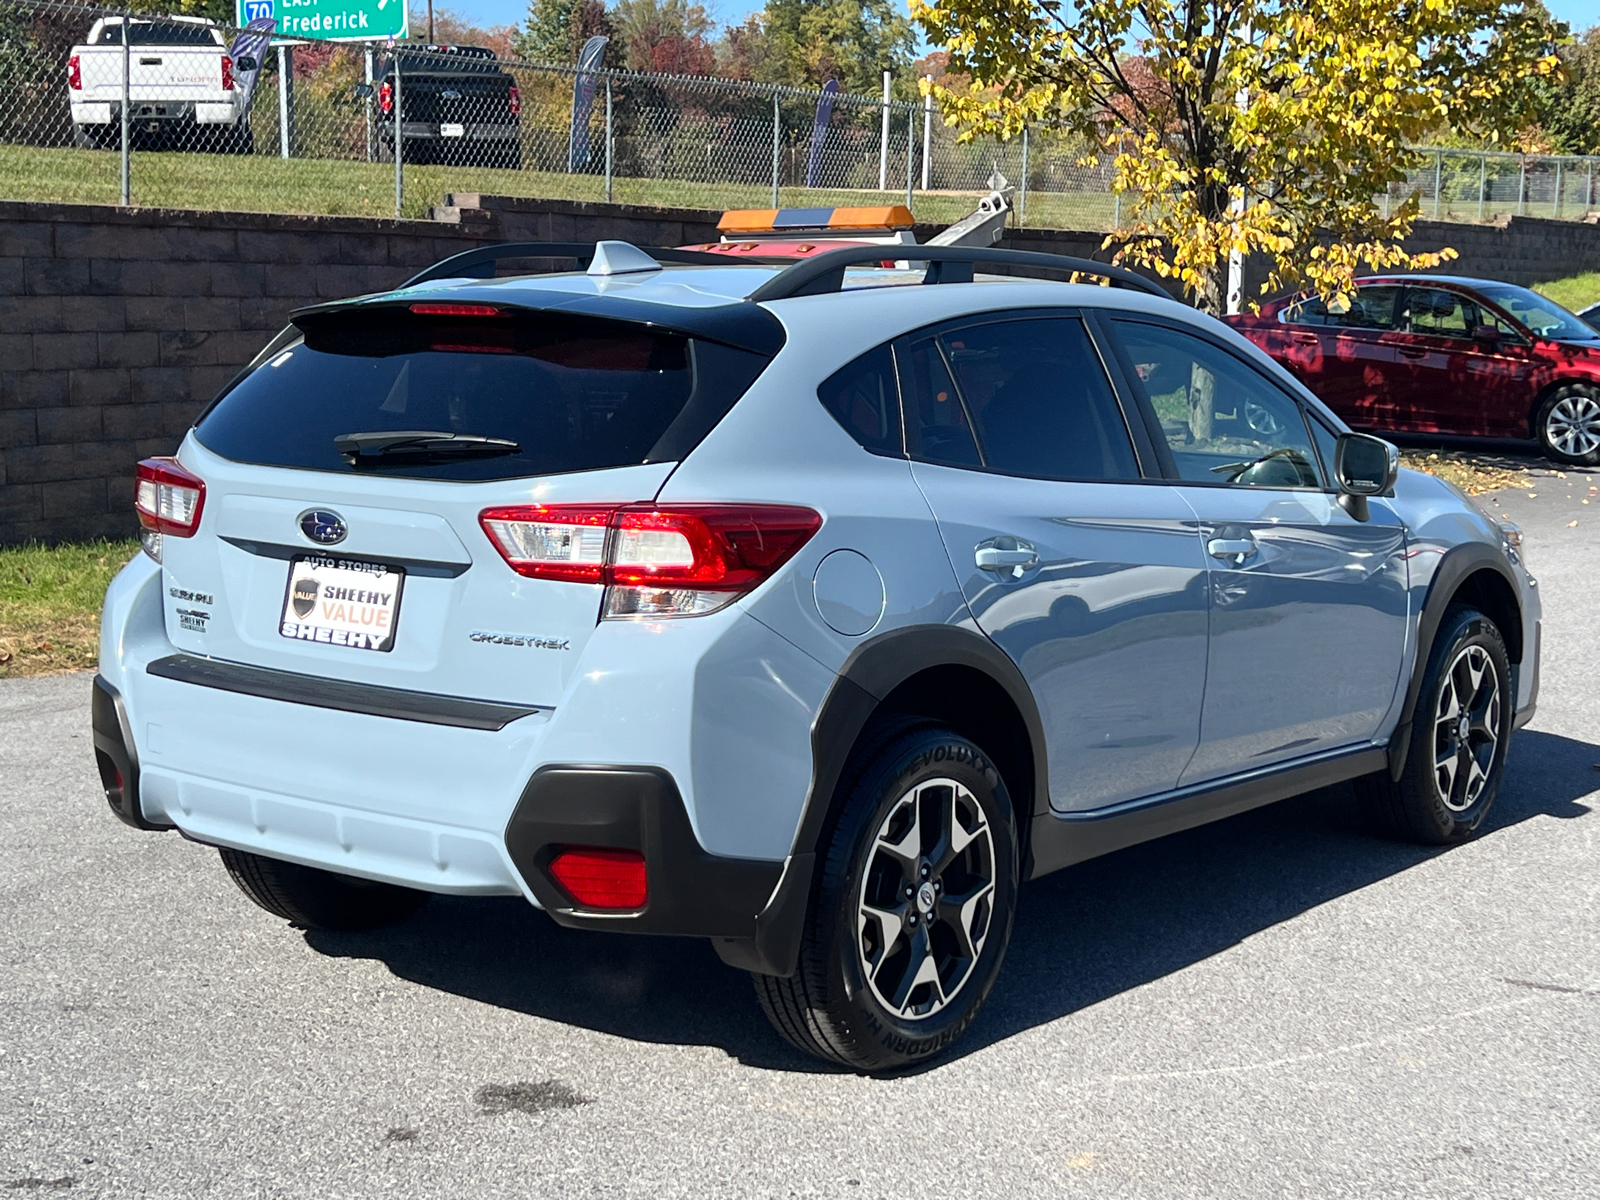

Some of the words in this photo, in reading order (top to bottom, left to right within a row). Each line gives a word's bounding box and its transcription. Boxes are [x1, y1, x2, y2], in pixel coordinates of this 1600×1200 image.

[249, 3, 270, 21] 70
[282, 10, 369, 33] Frederick
[302, 556, 335, 569] AUTO
[338, 559, 388, 575] STORES
[293, 590, 316, 601] VALUE
[323, 585, 392, 606] SHEEHY
[322, 601, 390, 628] VALUE
[281, 621, 391, 650] SHEEHY
[469, 630, 570, 651] CROSSTREK
[908, 744, 990, 777] EVOLUXX
